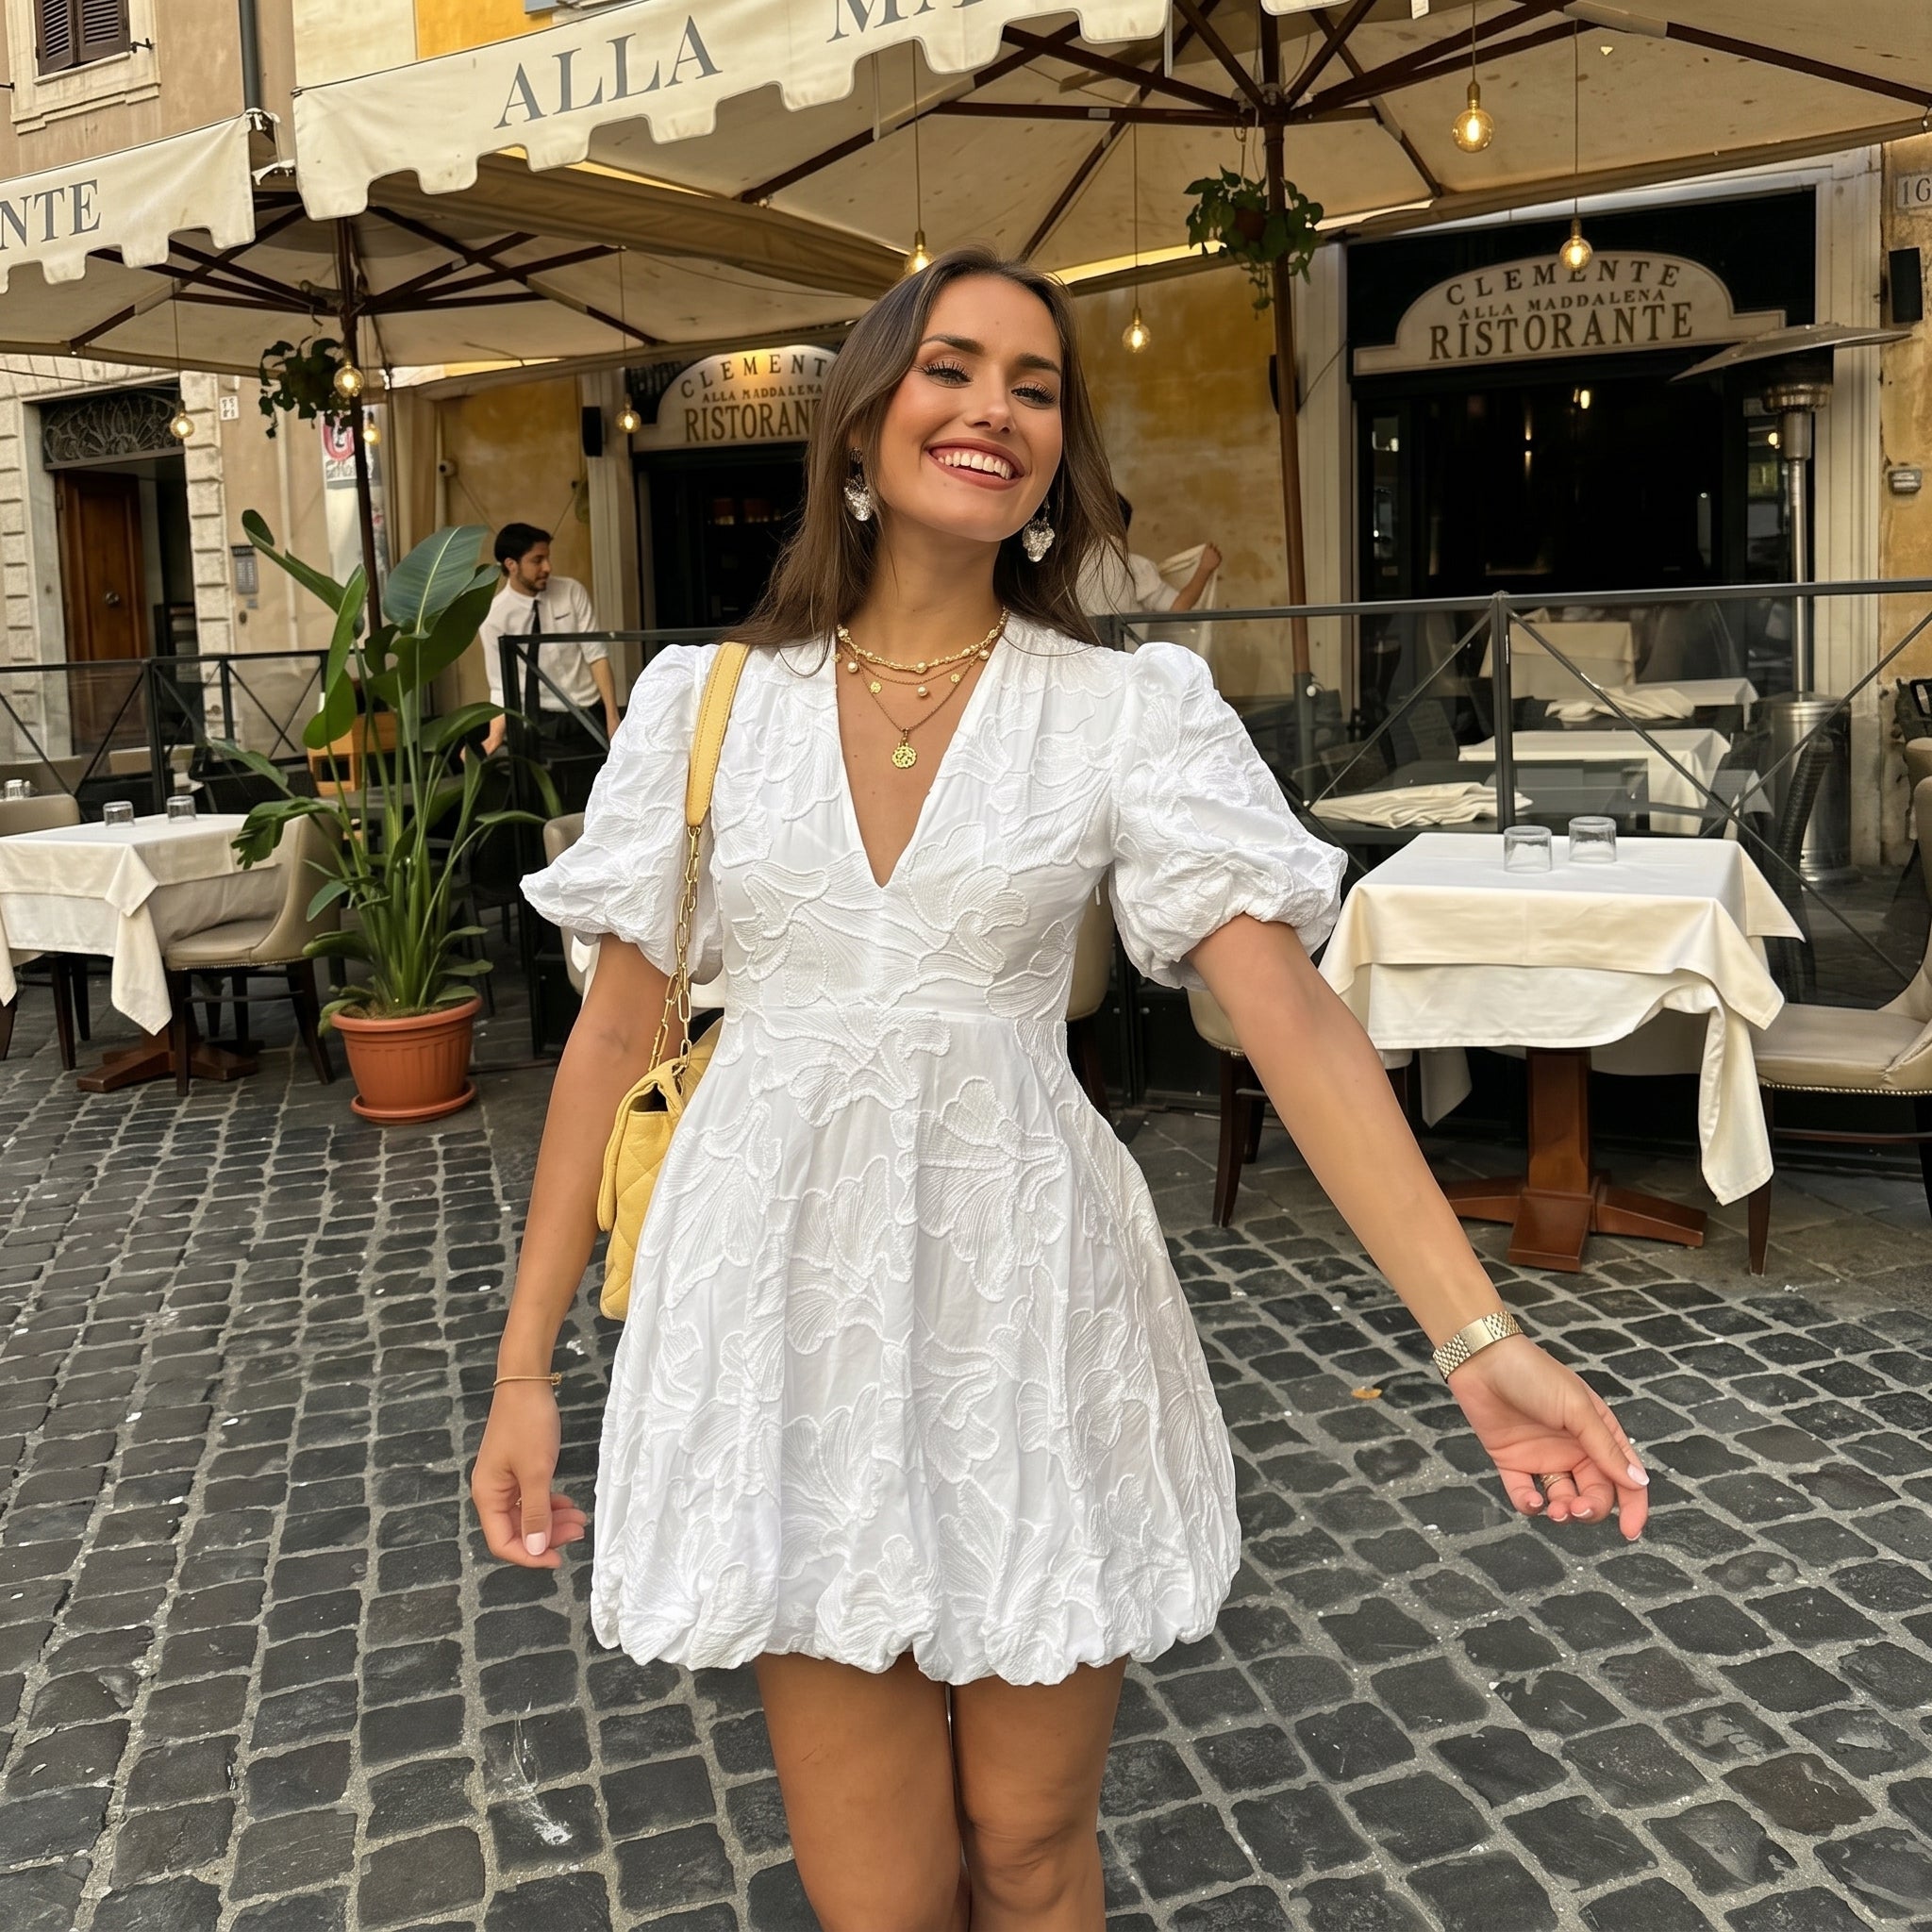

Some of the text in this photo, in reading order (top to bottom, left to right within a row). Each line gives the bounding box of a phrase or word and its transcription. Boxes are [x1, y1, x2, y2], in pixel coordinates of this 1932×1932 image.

[493, 14, 724, 129] ALLA
[1445, 259, 1681, 306] CLEMENTE
[1458, 288, 1666, 322] ALLA MADDALENA
[1428, 301, 1693, 361] RISTORANTE
[702, 391, 737, 404] ALLA
